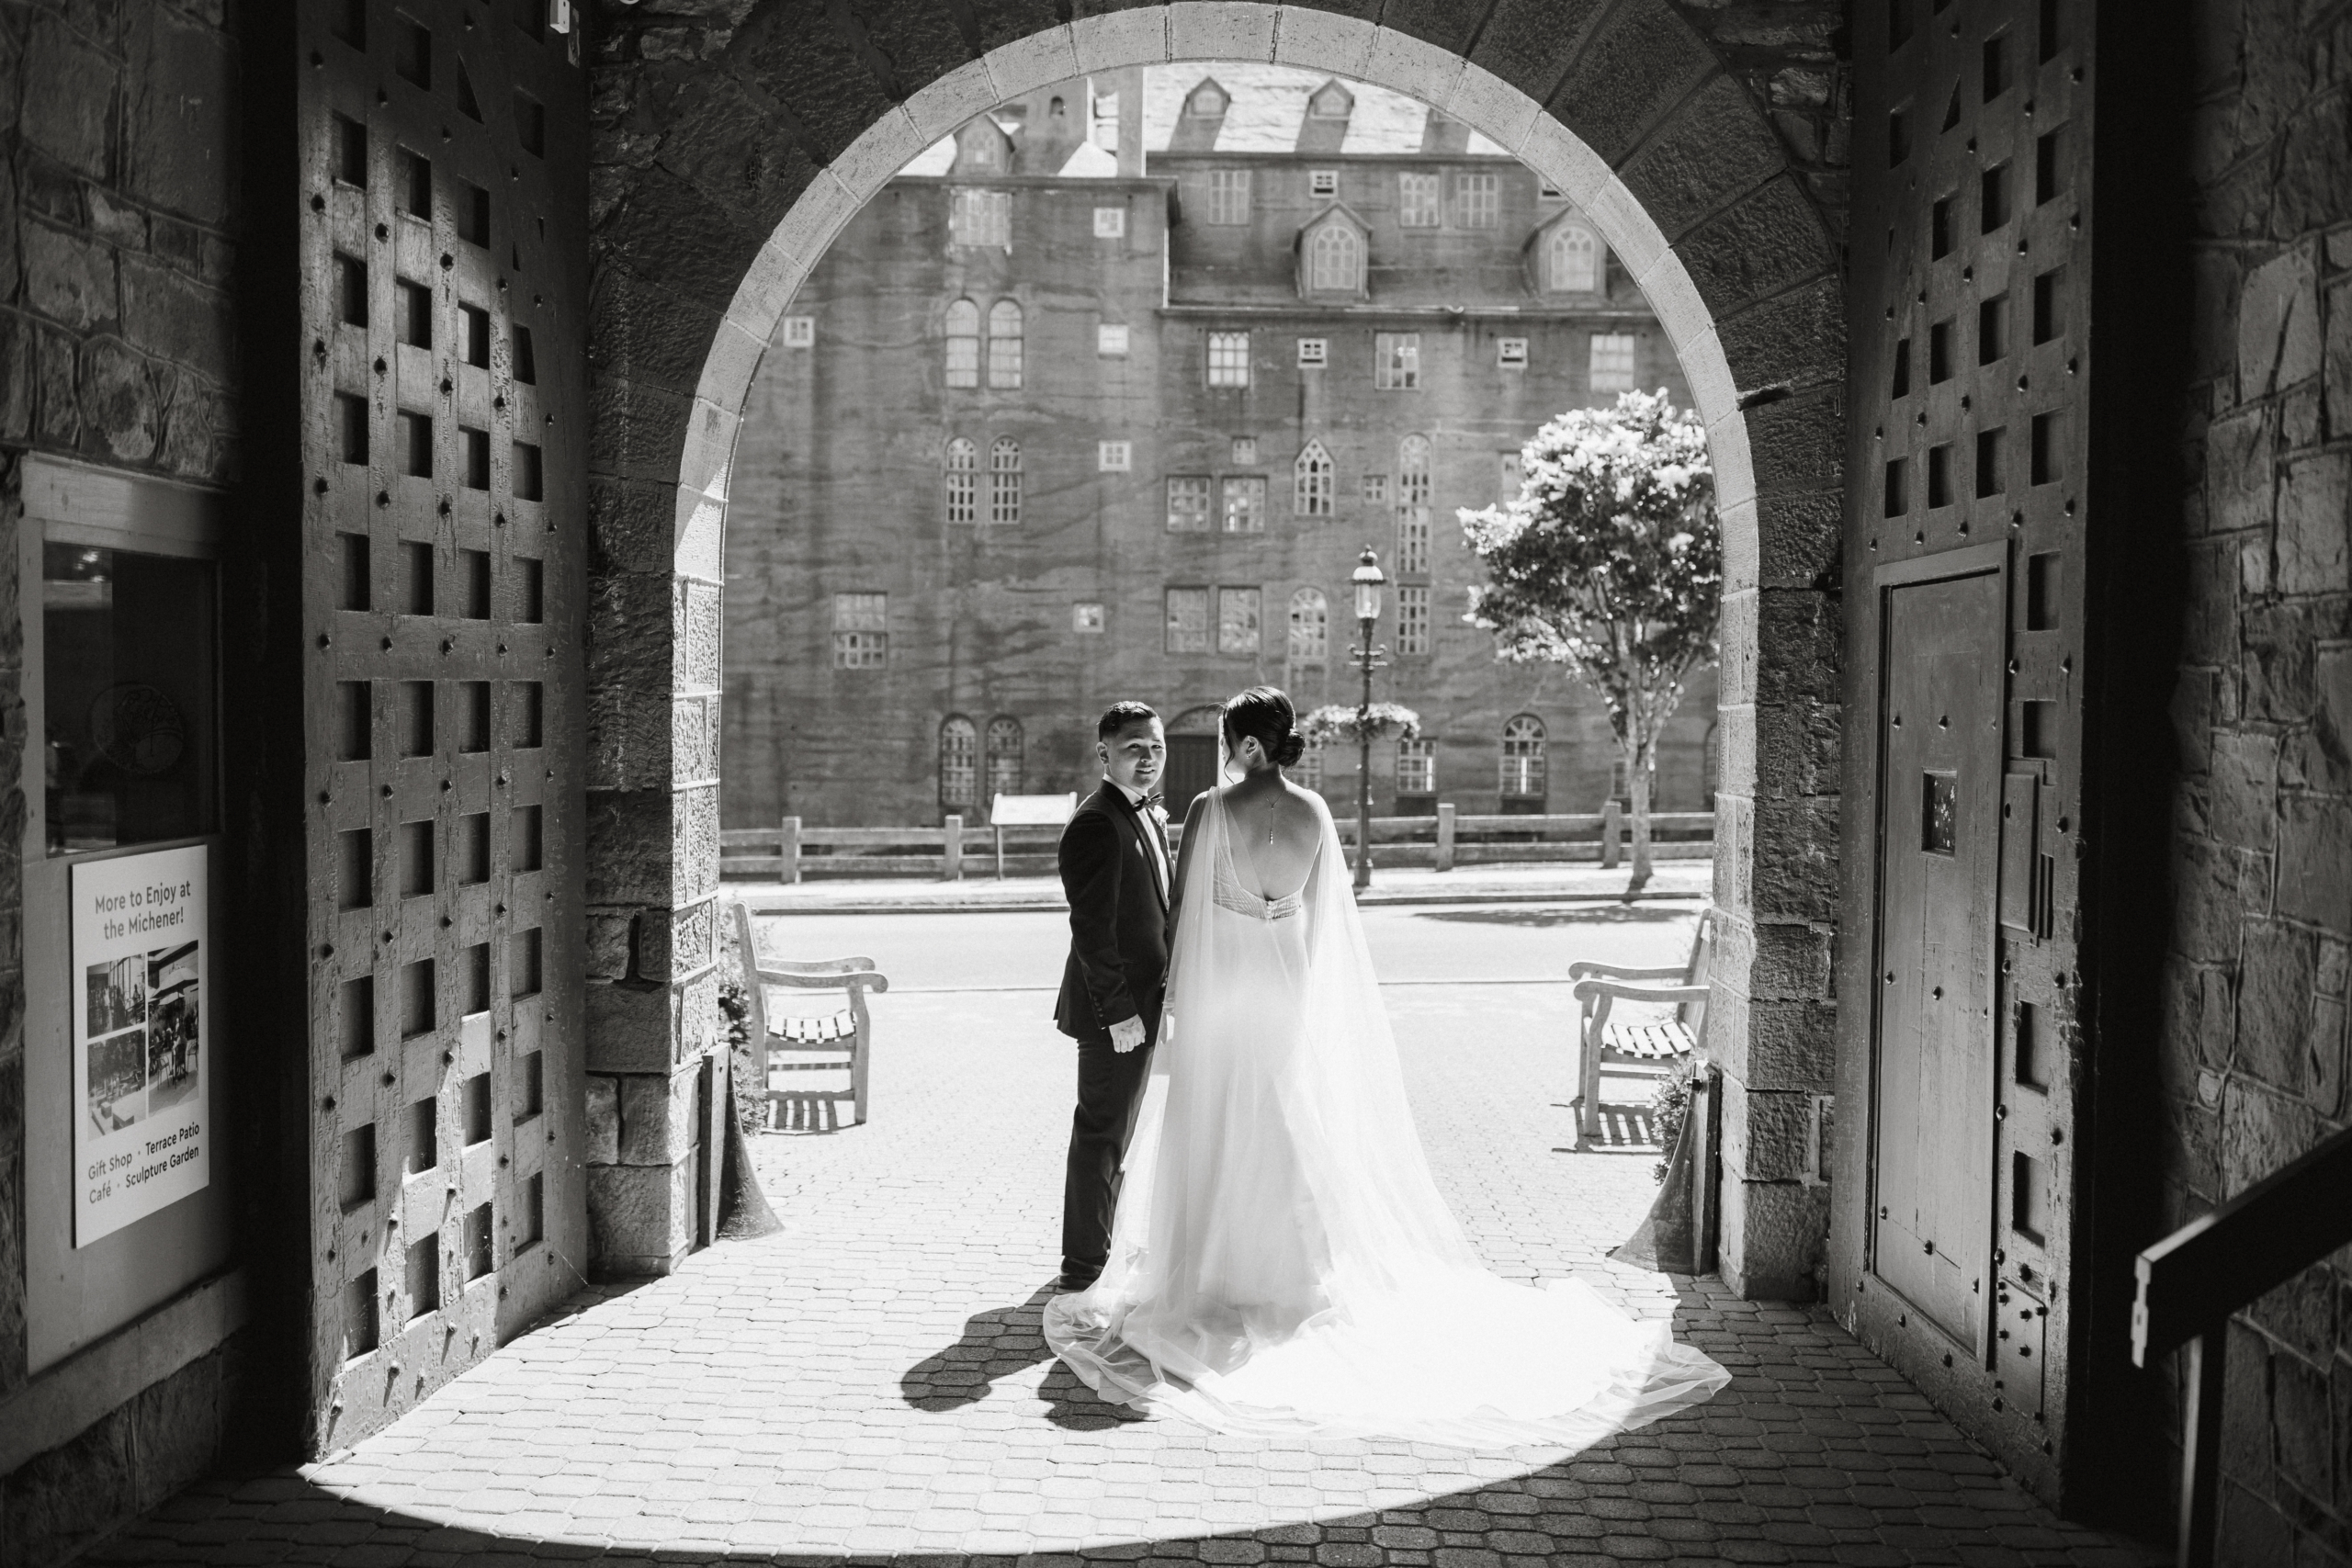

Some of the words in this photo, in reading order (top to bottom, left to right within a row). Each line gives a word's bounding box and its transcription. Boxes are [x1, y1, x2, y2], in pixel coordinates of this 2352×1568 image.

[96, 895, 126, 914] More
[130, 890, 142, 908] to
[146, 882, 176, 907] Enjoy
[180, 880, 191, 897] at
[104, 919, 124, 940] the
[129, 907, 184, 934] Michener!
[88, 1161, 107, 1180] Gift
[109, 1153, 132, 1172] Shop
[145, 1134, 177, 1156] Terrace
[179, 1121, 199, 1142] Patio
[89, 1180, 111, 1204] Café
[126, 1161, 167, 1189] Sculpture
[170, 1145, 199, 1168] Garden
